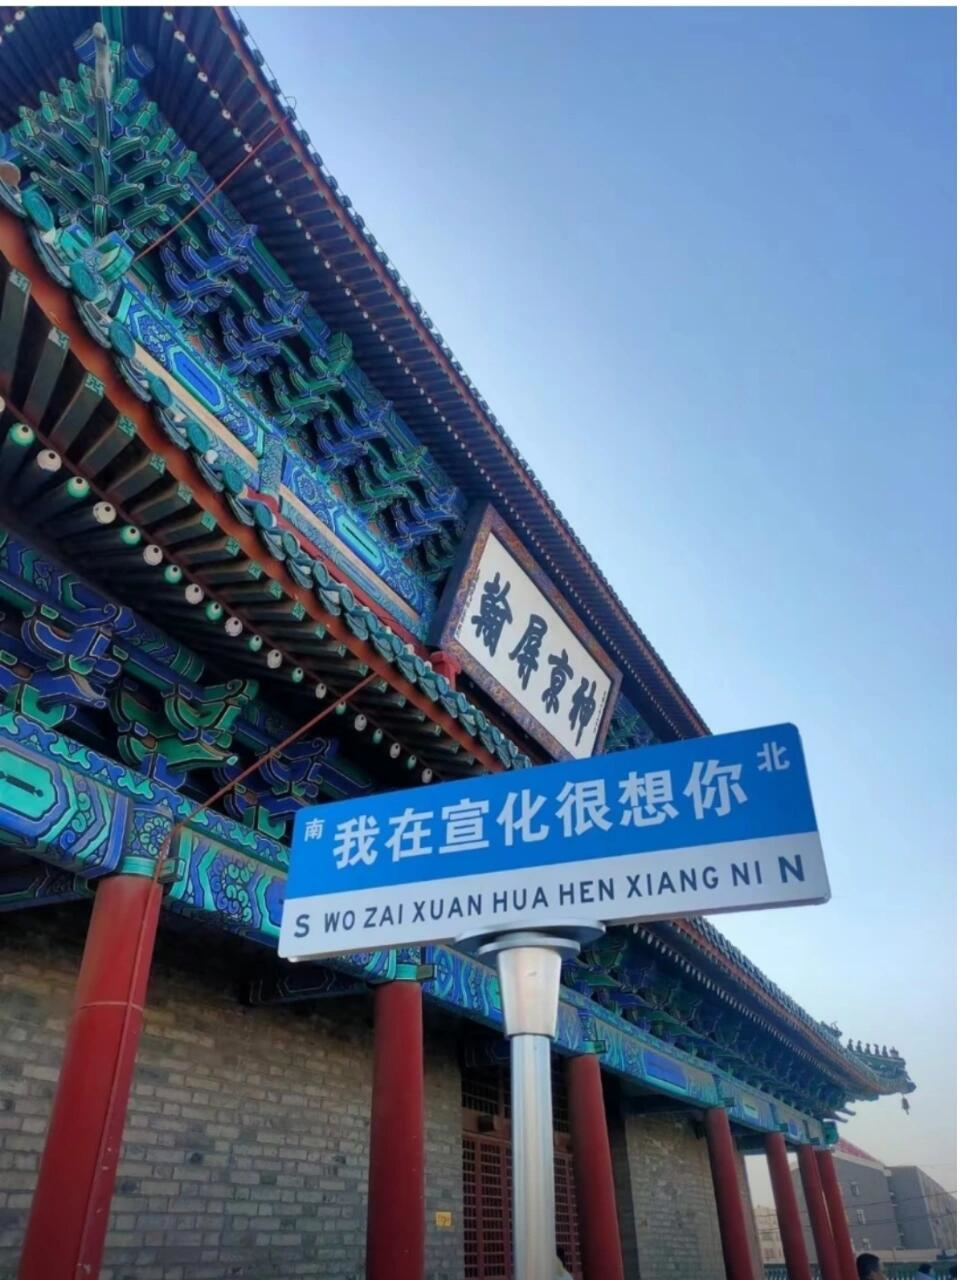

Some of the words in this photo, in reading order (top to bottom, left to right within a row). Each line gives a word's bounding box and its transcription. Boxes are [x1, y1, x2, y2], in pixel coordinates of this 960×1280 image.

[303, 817, 326, 842] 南
[332, 759, 748, 870] 我在宣化很想你
[756, 740, 791, 773] 北
[293, 913, 310, 938] S
[323, 910, 356, 934] WO
[363, 903, 404, 929] ZAI
[411, 893, 482, 924] XUAN
[492, 886, 549, 914] HUA
[559, 877, 615, 906] HEN
[626, 865, 719, 899] XIANG
[731, 860, 763, 887] NI
[778, 854, 806, 884] N
